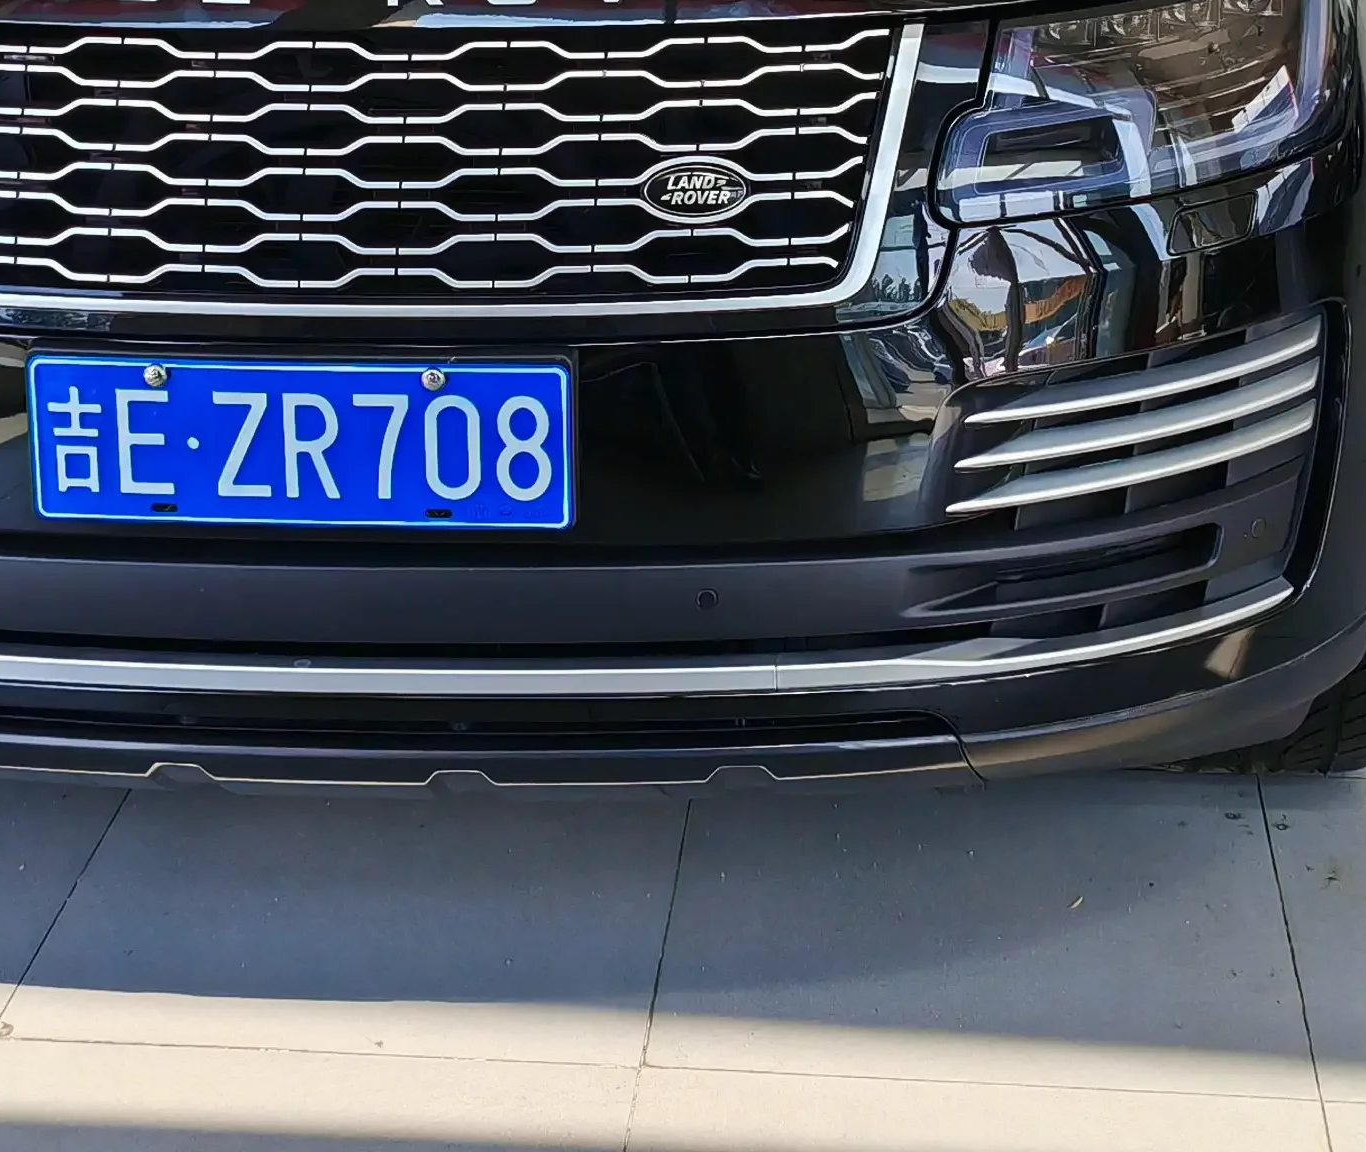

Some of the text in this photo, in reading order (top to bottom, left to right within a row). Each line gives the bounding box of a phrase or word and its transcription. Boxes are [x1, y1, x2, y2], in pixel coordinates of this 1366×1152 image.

[666, 174, 716, 191] LAND
[670, 190, 732, 206] ROVER
[46, 385, 554, 503] 吉E·ZR708
